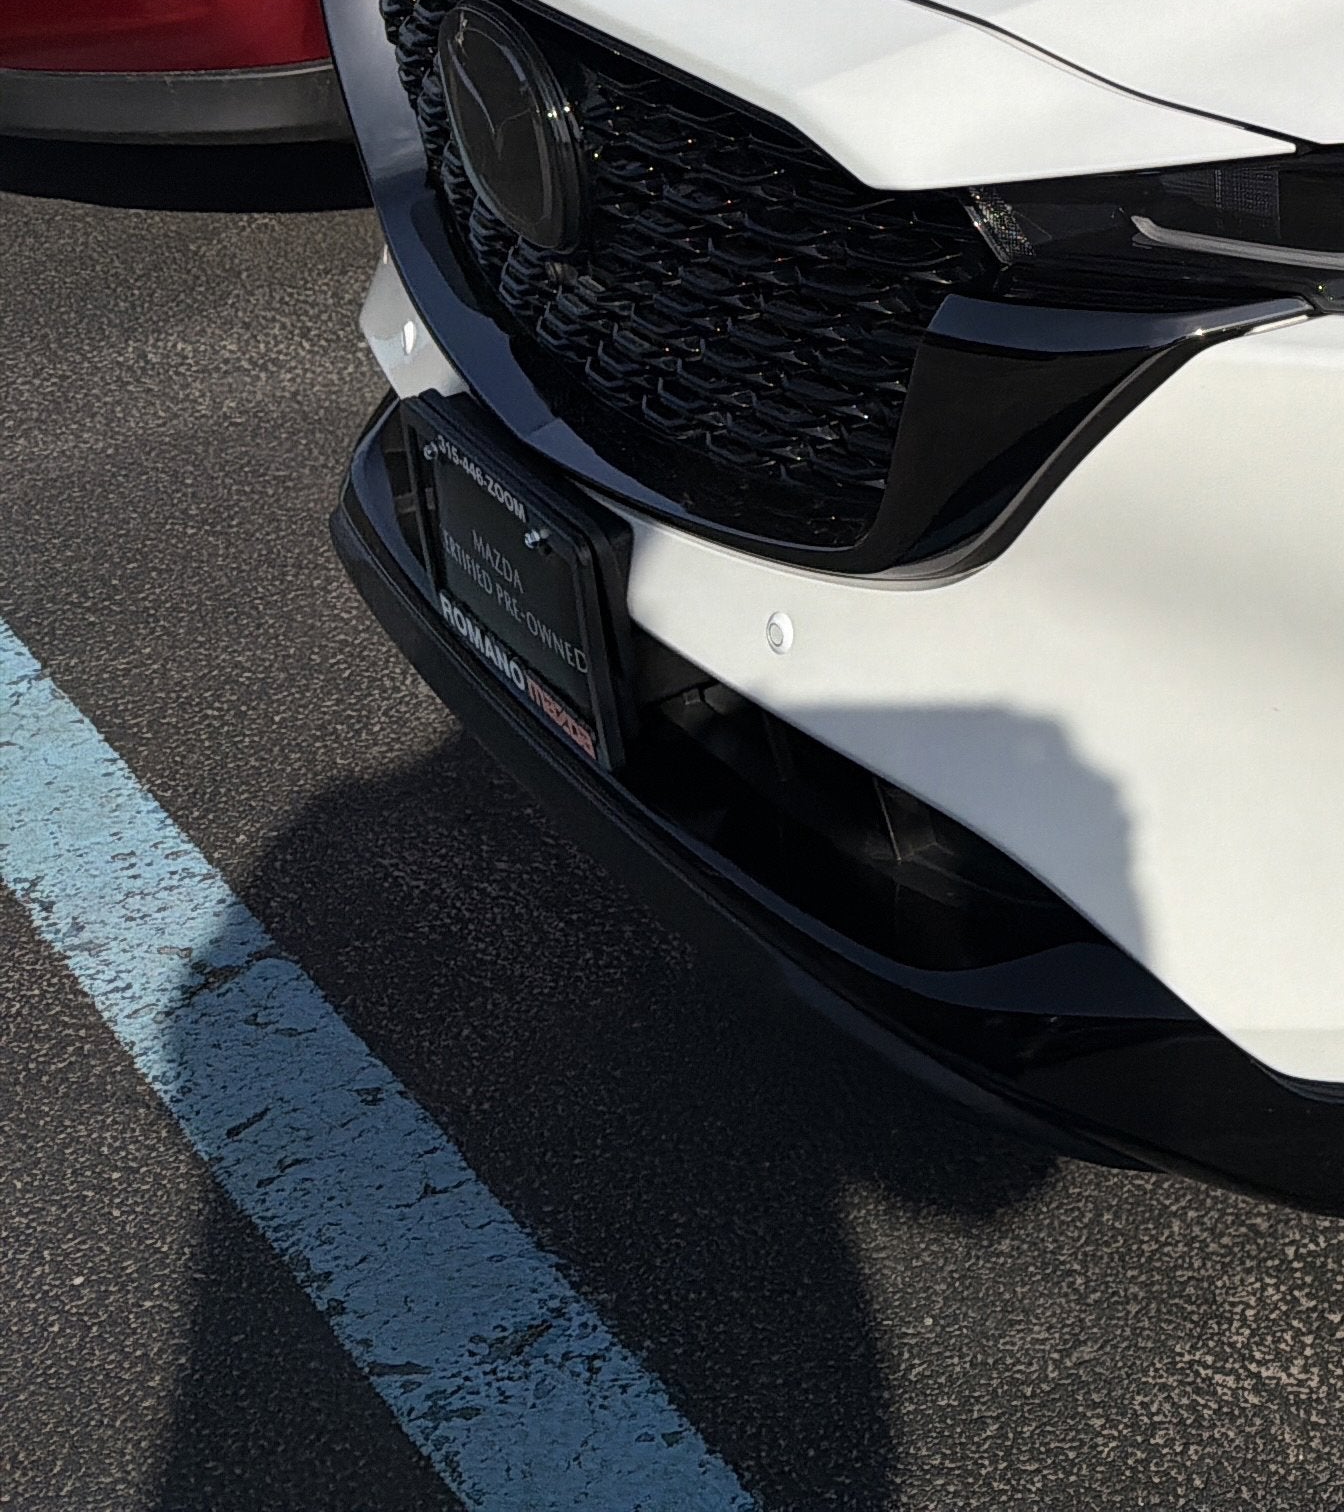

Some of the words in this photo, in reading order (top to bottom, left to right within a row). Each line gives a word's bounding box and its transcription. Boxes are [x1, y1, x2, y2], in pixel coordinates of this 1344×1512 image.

[441, 527, 493, 596] ERTIFIED
[496, 582, 588, 674] PRE-OWNED
[472, 529, 525, 595] MAZDA
[440, 591, 526, 691] ROMANO
[524, 676, 597, 761] mazda
